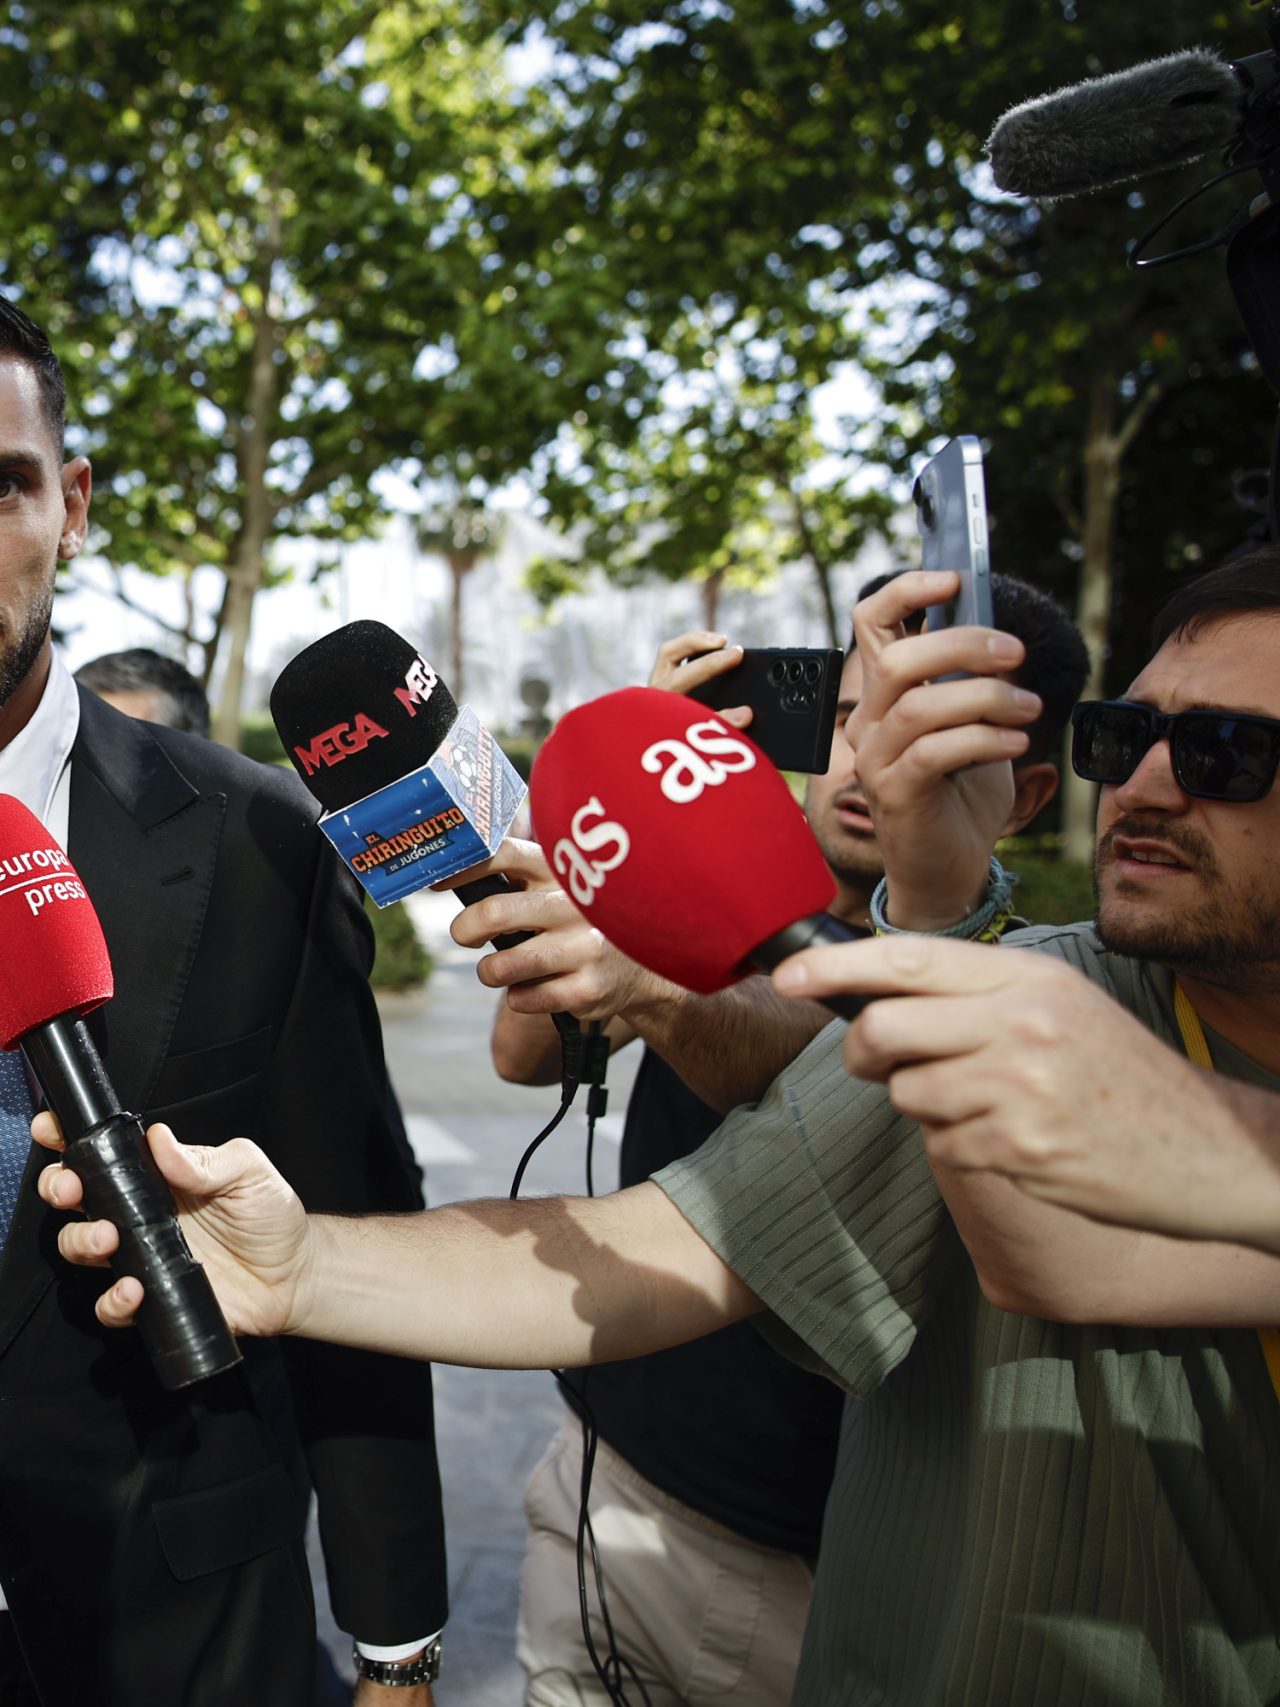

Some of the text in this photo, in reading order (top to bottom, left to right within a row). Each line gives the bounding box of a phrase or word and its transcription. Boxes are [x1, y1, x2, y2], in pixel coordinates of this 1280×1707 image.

[393, 653, 438, 717] MEG
[294, 712, 389, 776] MEGA
[641, 719, 756, 803] as
[351, 807, 465, 873] CHIRINGUITO
[365, 833, 380, 844] EL
[400, 838, 446, 867] JUGONES
[554, 796, 630, 906] as
[24, 881, 86, 916] press
